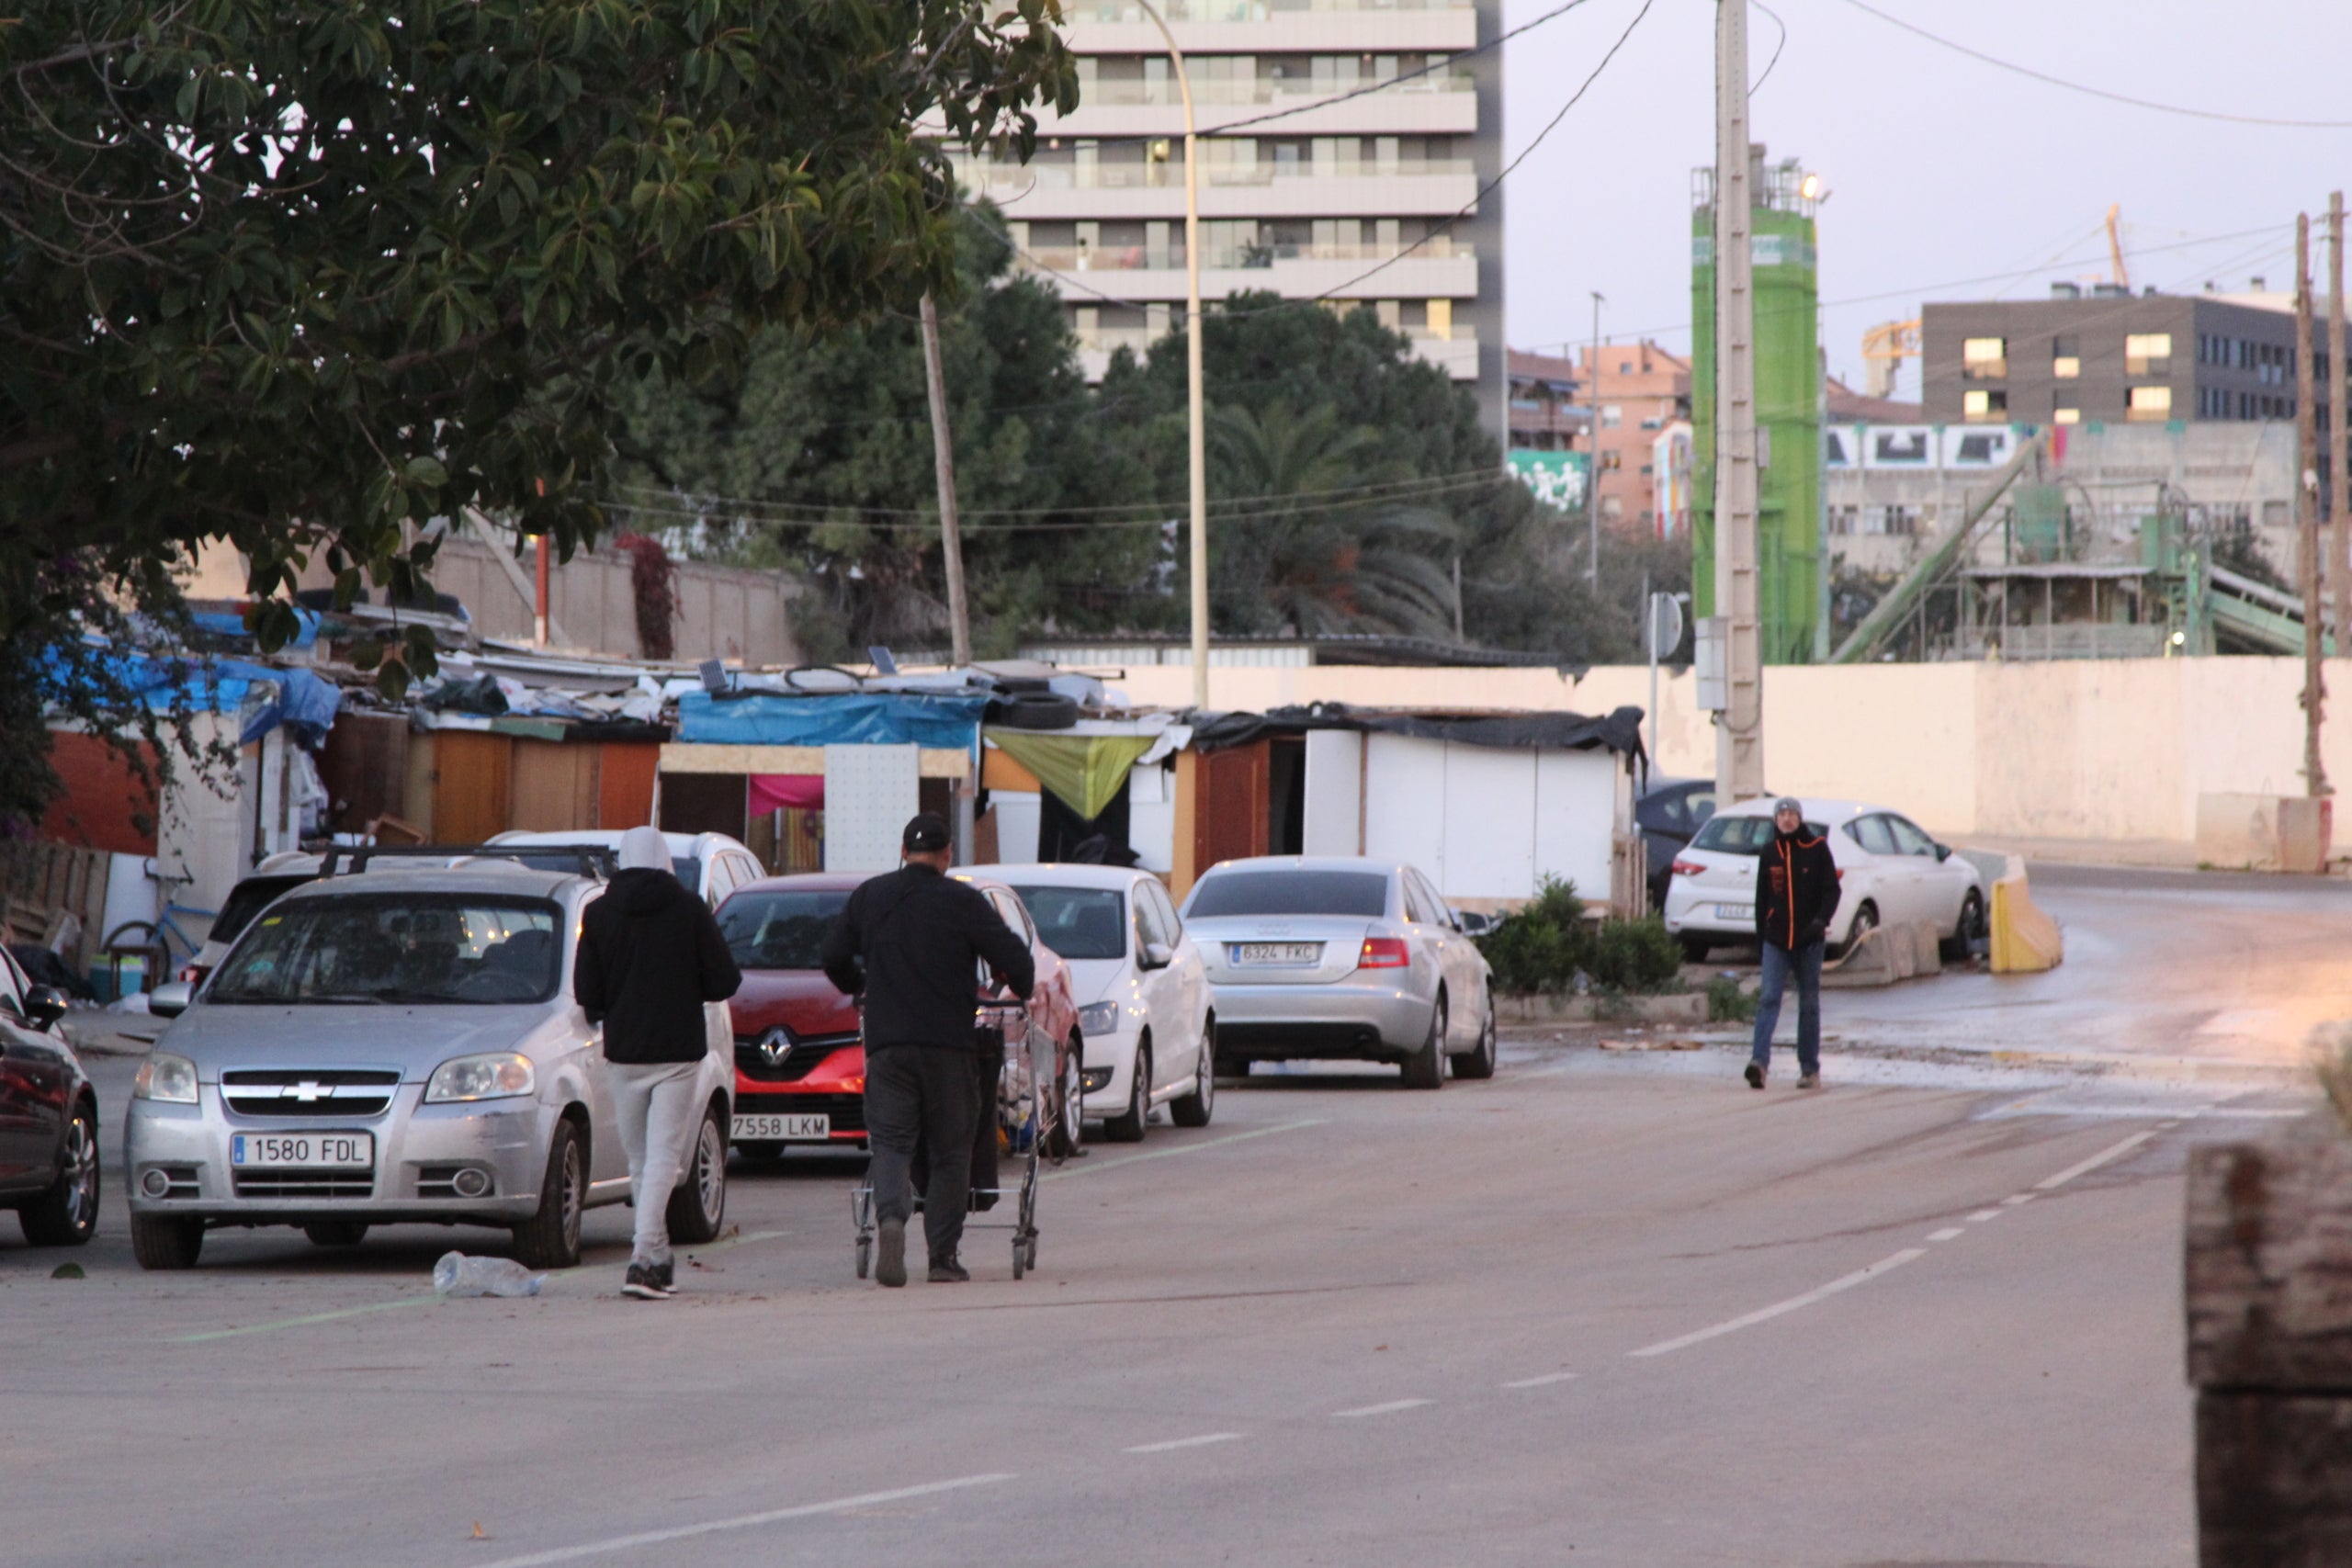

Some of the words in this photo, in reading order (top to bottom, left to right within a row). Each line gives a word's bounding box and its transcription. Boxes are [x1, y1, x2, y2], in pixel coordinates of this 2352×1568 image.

[1243, 945, 1277, 960] 6324
[1285, 945, 1312, 960] FKC
[733, 1118, 781, 1135] 7558
[788, 1118, 825, 1135] LKM
[255, 1139, 310, 1161] 1580
[322, 1139, 364, 1161] FDL
